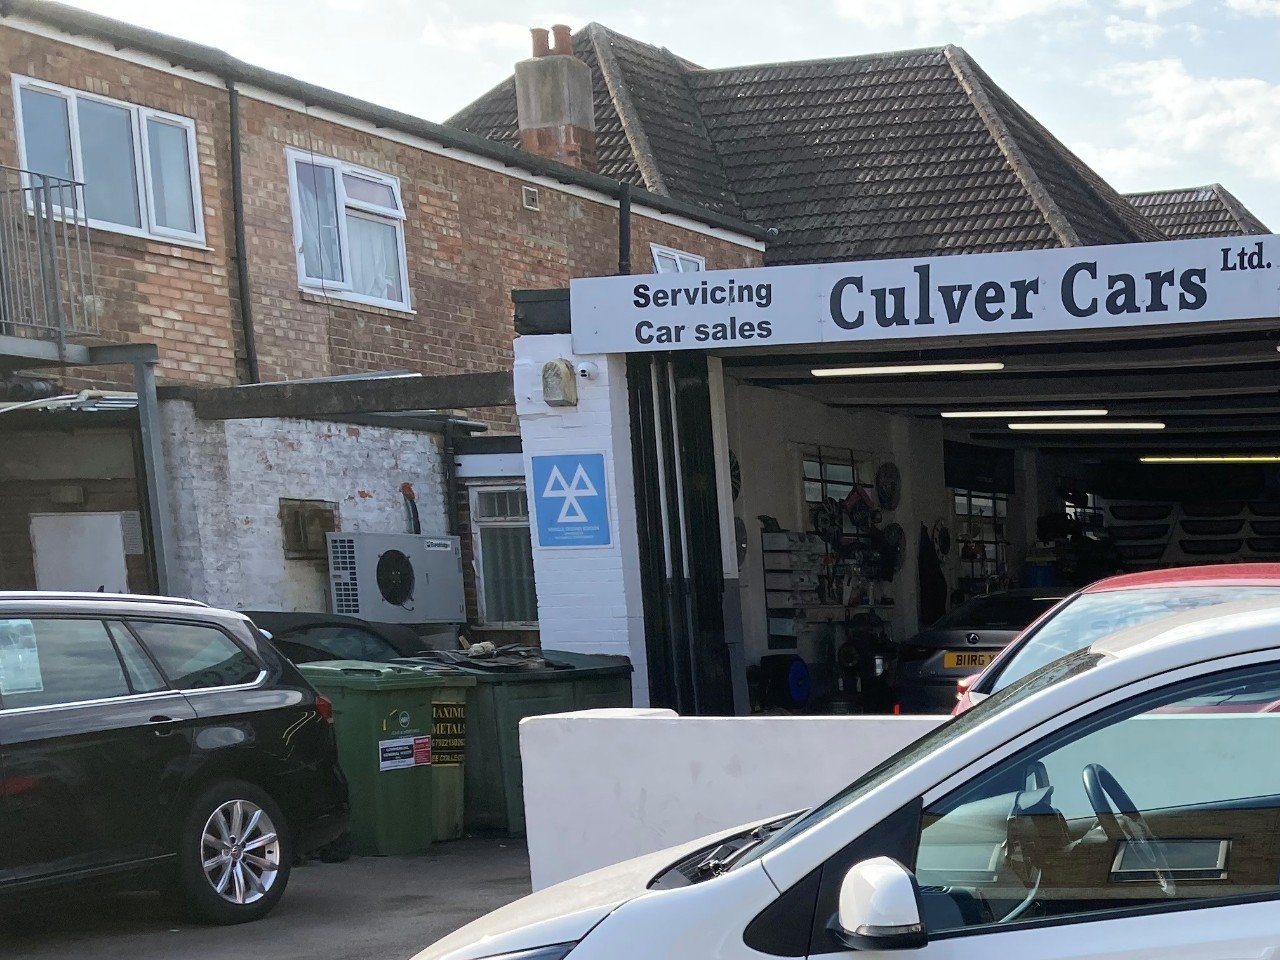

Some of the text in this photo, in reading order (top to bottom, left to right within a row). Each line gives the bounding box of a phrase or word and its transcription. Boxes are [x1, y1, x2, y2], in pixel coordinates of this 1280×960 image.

[633, 279, 773, 309] Servicing
[830, 242, 1273, 331] Culver Cars Ltd.
[634, 316, 773, 345] Car sales
